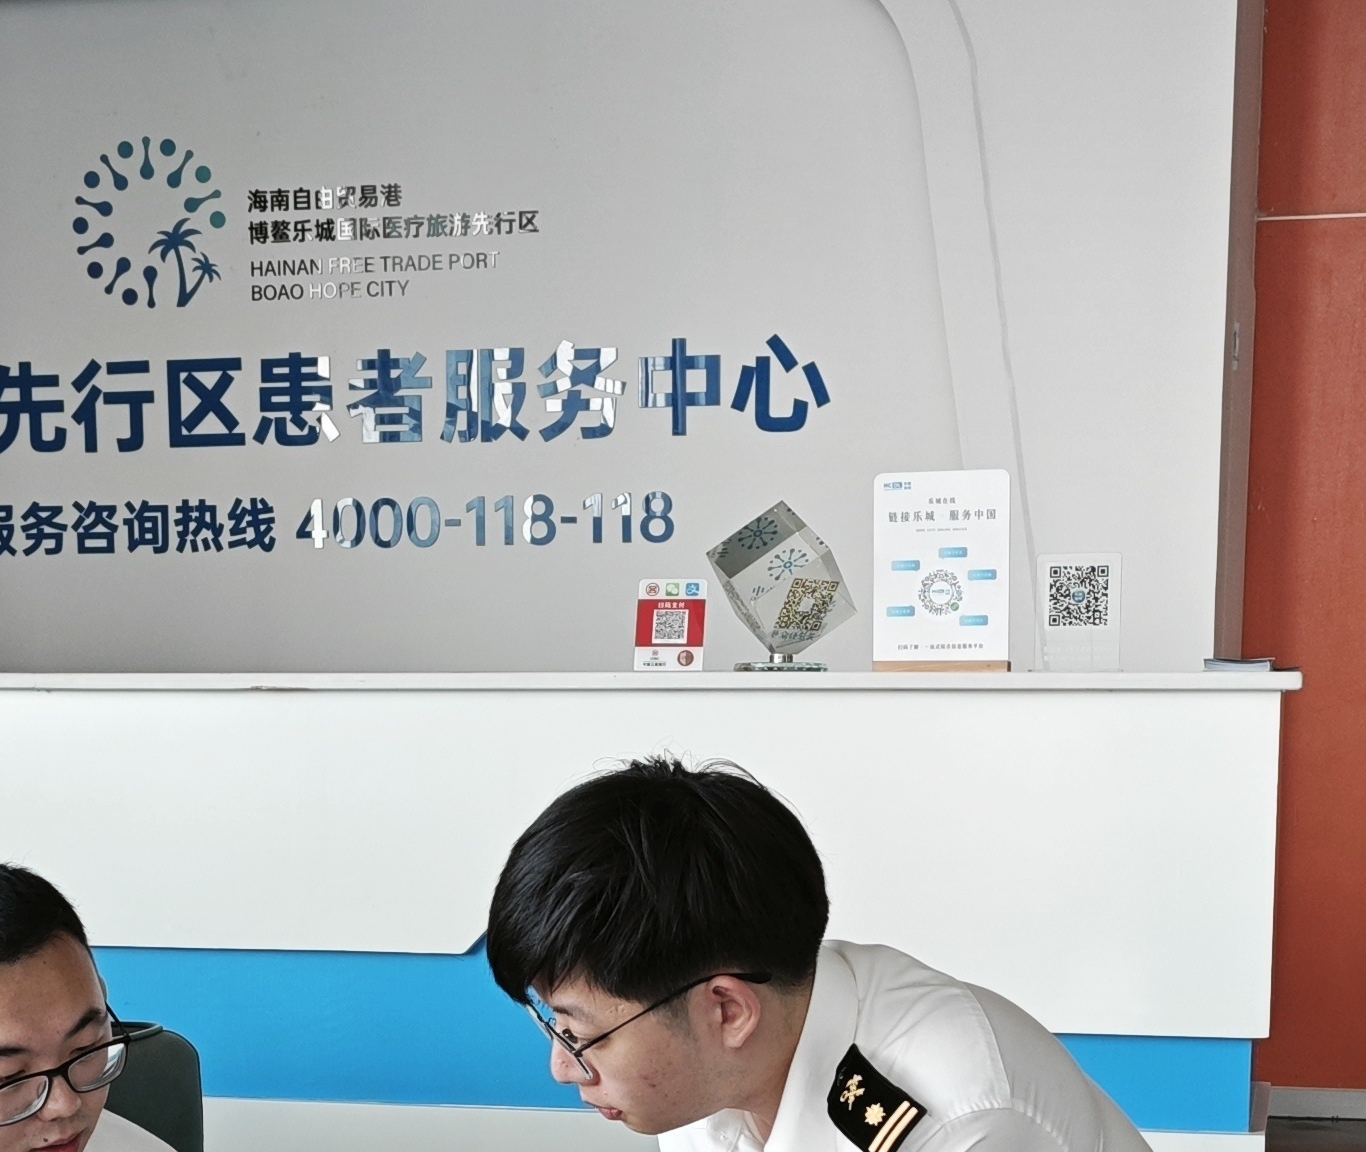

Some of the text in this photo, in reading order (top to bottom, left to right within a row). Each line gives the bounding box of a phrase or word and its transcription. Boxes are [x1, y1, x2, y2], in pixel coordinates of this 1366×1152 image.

[247, 183, 402, 213] 海南自由贸易港
[247, 210, 540, 245] 博鳌乐城国际医疗旅游先行区
[250, 251, 500, 277] HAINAN FREE TRADE PORT
[250, 280, 410, 301] BOAO HOPE CITY
[295, 491, 675, 551] 4000-118-118
